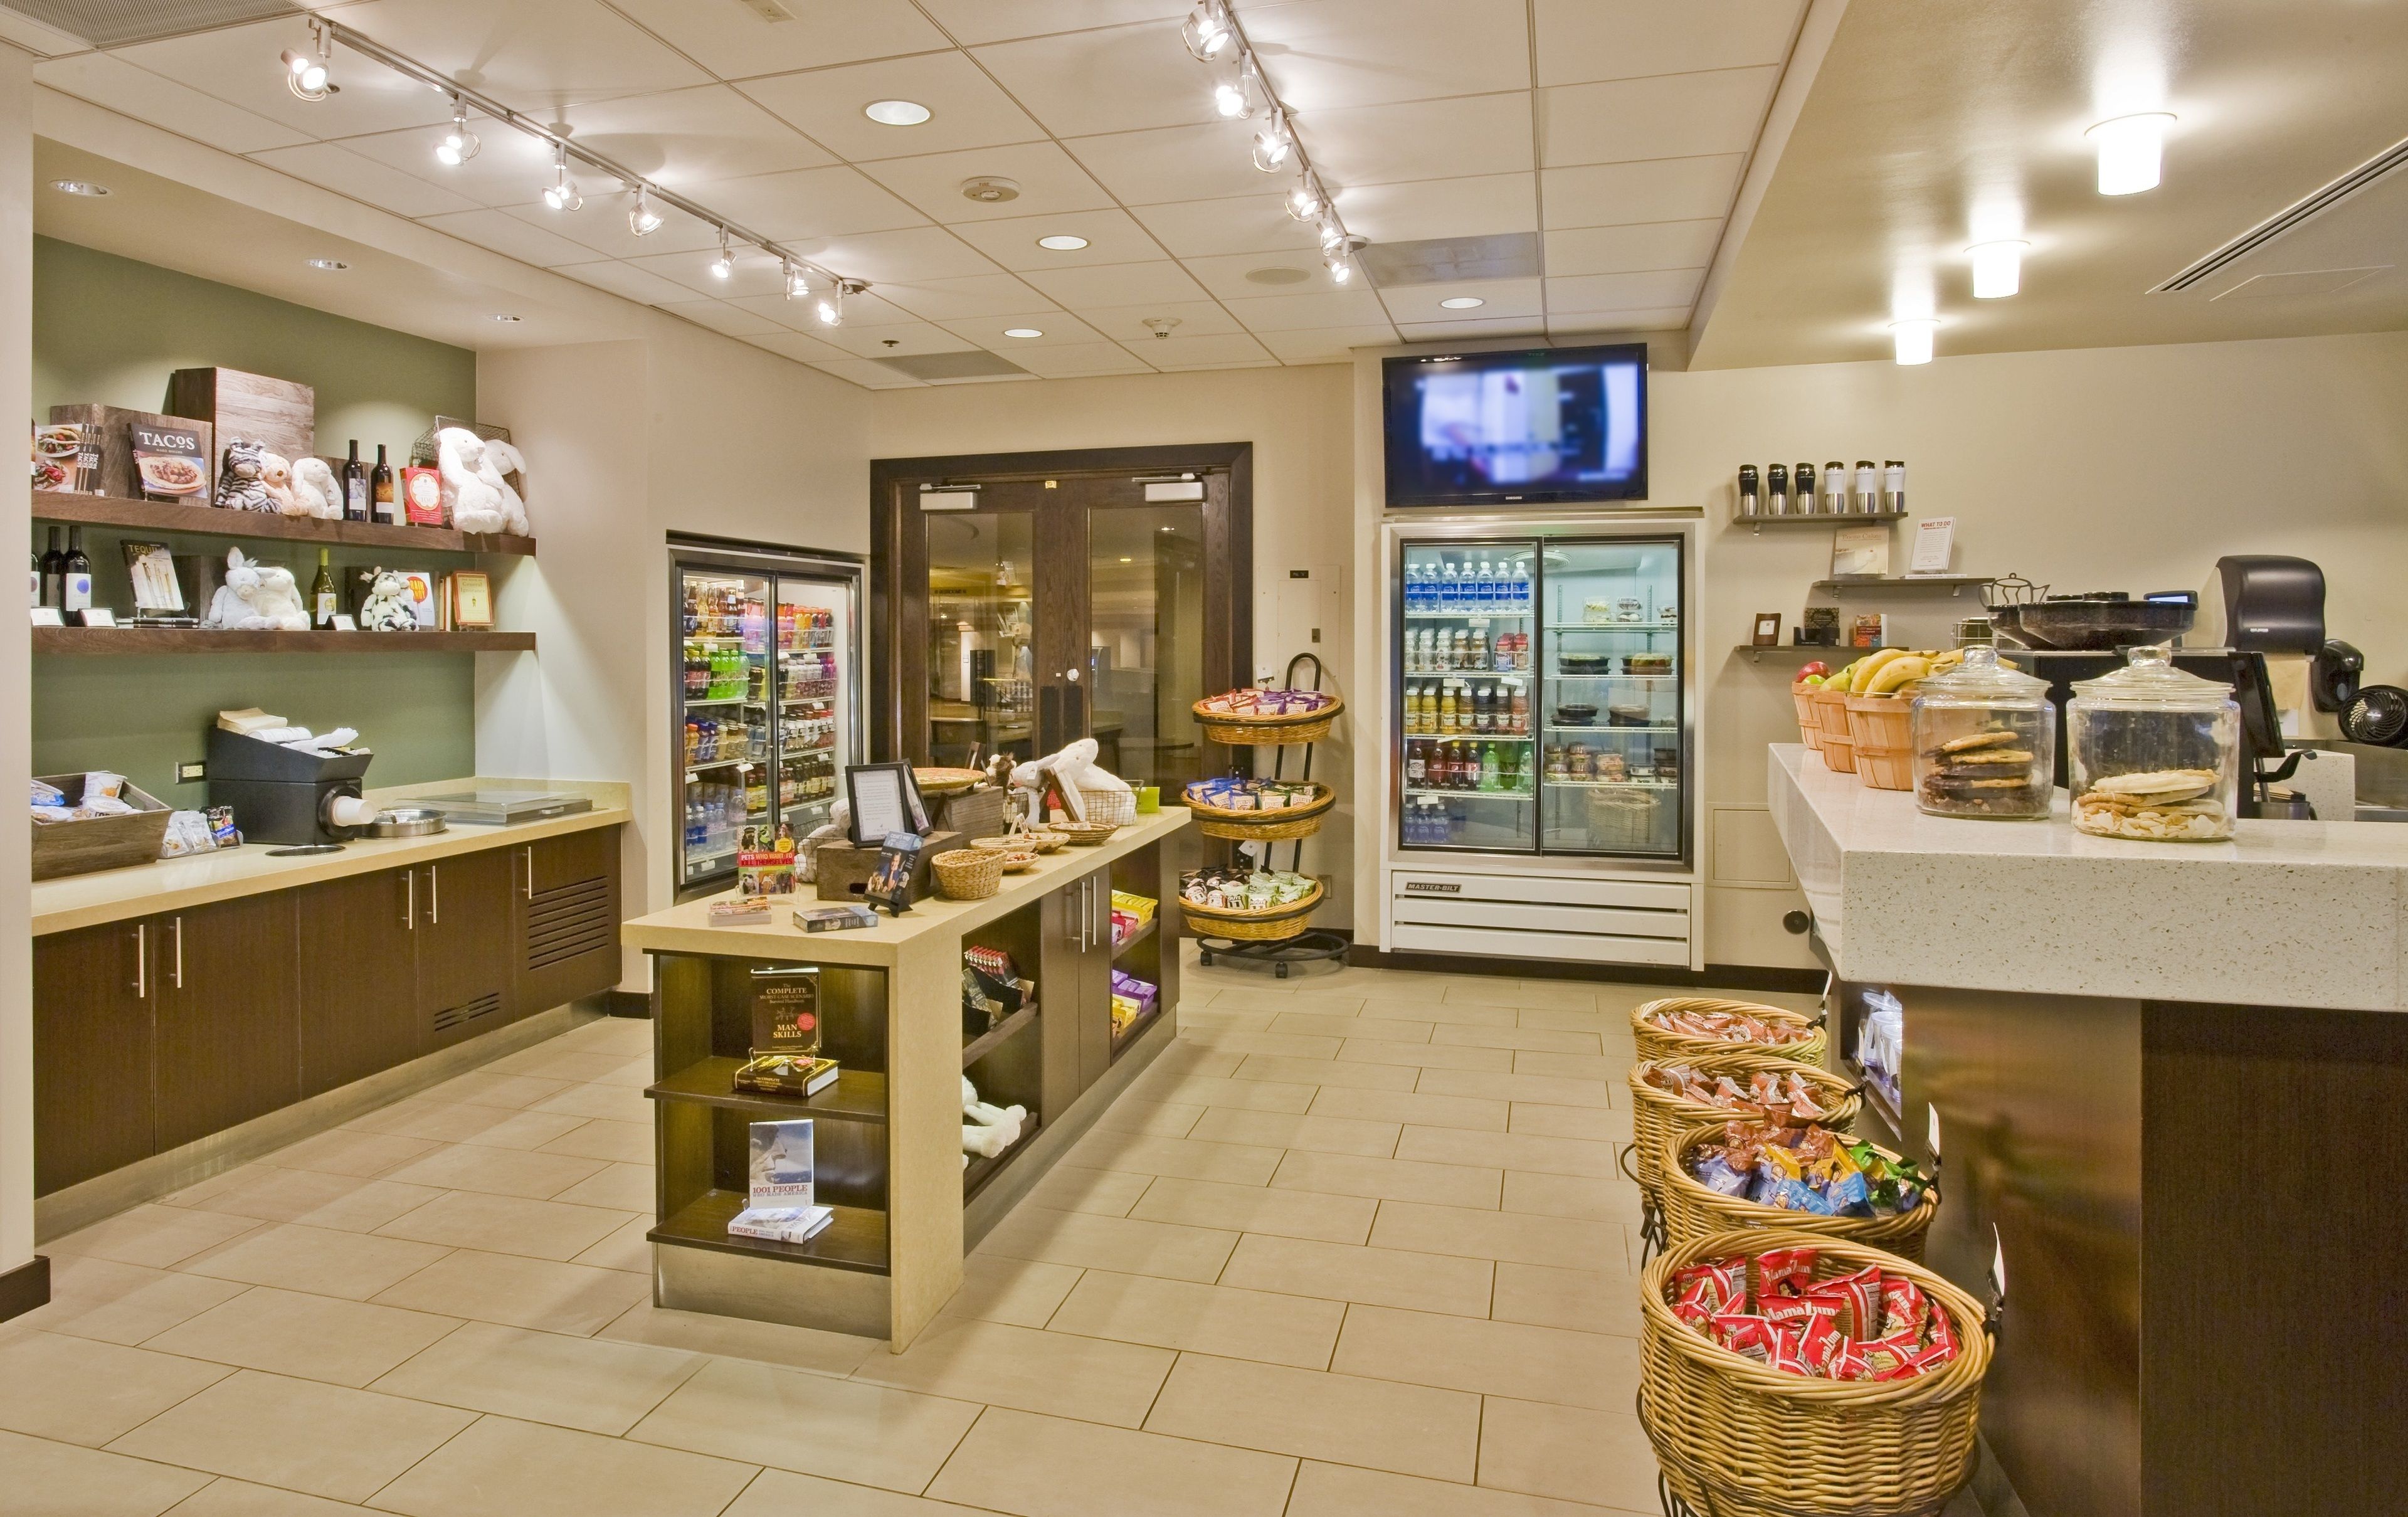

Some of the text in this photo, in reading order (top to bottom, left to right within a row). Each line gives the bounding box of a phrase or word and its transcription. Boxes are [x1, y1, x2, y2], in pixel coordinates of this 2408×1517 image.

[139, 431, 195, 450] TACOS
[773, 1185, 808, 1193] PEOPLE
[732, 1226, 758, 1235] PEOPLE
